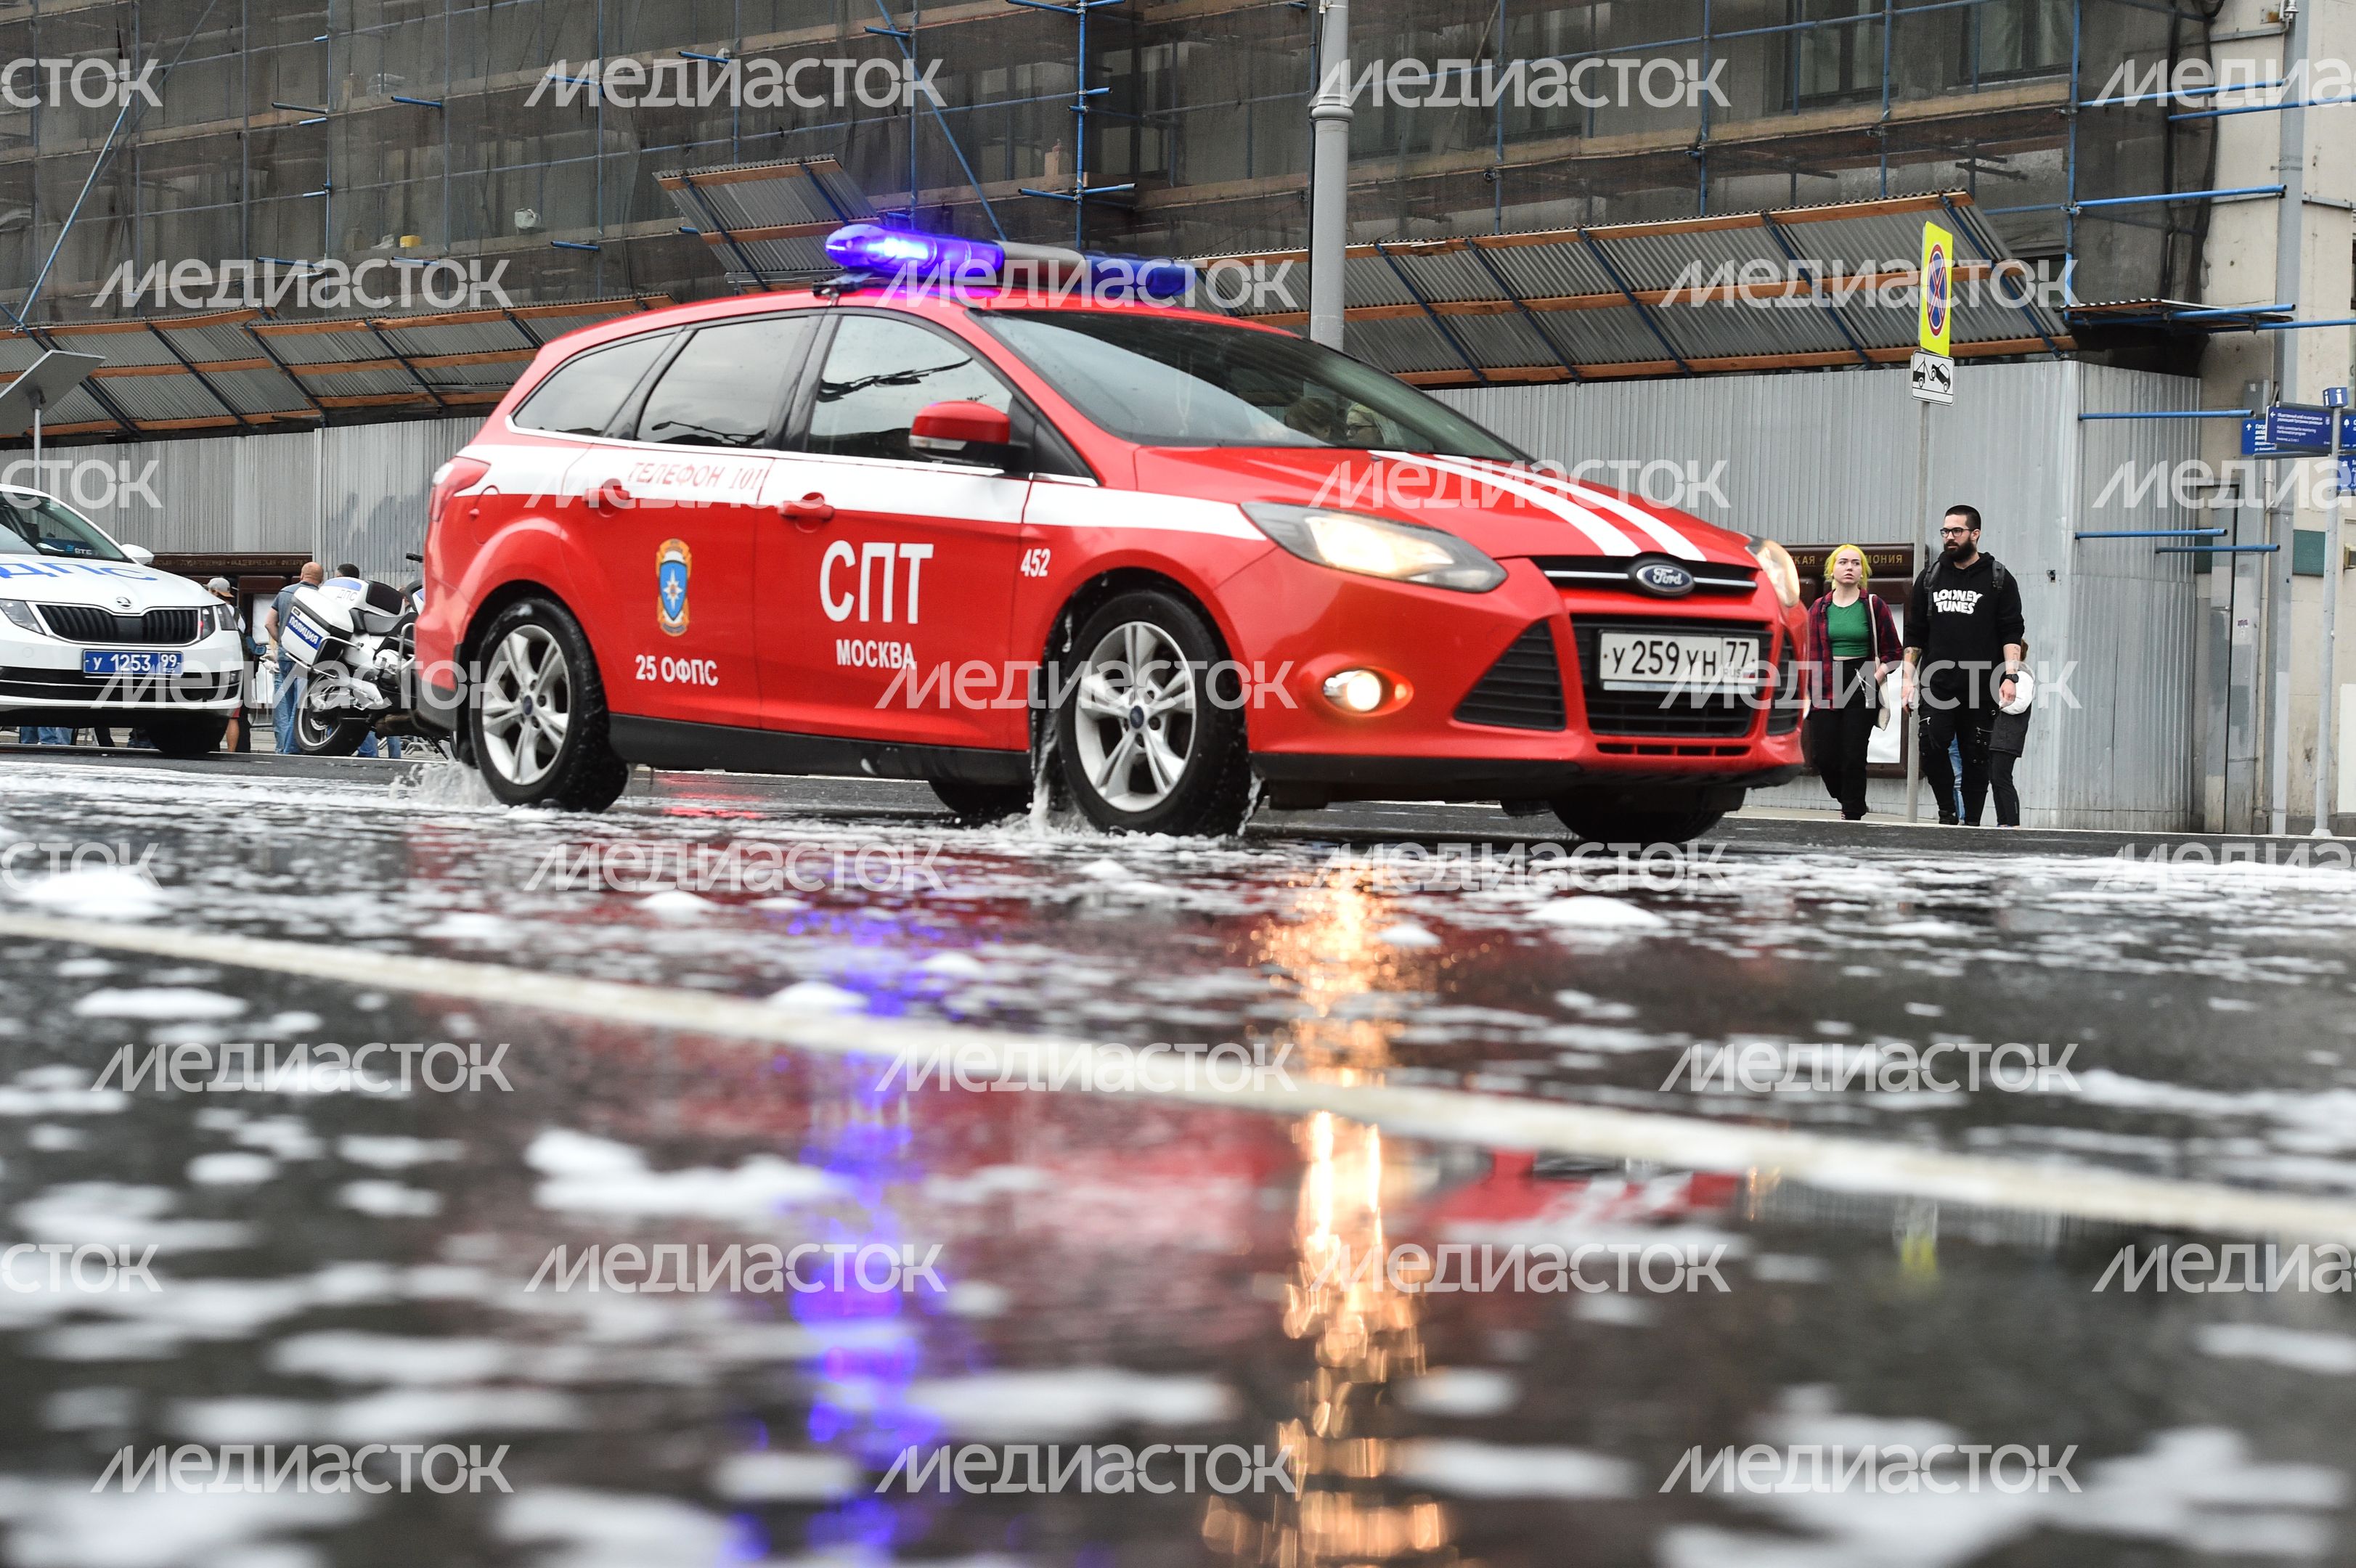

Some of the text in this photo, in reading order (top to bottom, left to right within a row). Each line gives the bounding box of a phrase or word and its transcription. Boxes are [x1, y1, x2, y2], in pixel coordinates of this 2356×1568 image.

[627, 462, 725, 488] ТЕЛЕФОН
[728, 467, 764, 489] 101
[1020, 548, 1051, 578] 452
[1791, 554, 1903, 565] КАЯ МОНИЯ
[0, 562, 158, 581] ДПС
[819, 539, 934, 624] СПТ
[1652, 567, 1683, 585] Ford
[336, 589, 358, 602] ДПС
[1933, 589, 1984, 603] LOONEY
[1936, 600, 1976, 615] TUNES
[288, 616, 319, 645] ПОЛИЦИЯ
[160, 654, 177, 667] 99
[836, 639, 917, 670] МОСКВА
[1725, 640, 1750, 668] 77
[635, 654, 719, 687] 25 ОФПС
